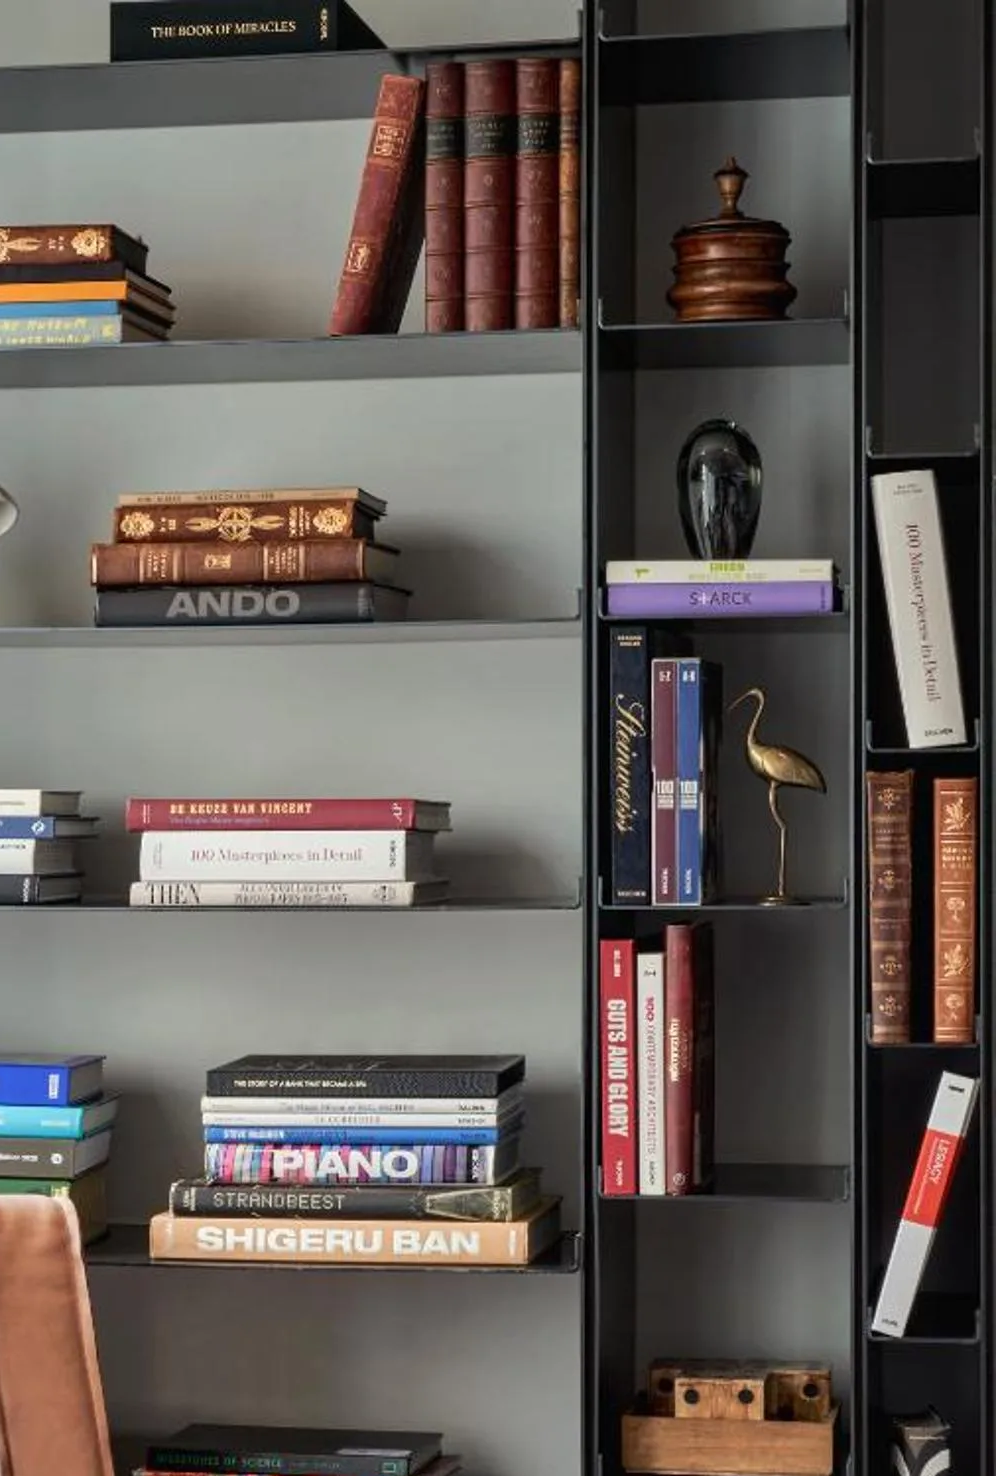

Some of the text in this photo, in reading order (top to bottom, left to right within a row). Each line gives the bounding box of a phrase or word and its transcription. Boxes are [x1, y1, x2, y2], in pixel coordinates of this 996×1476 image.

[151, 21, 297, 39] THE BOOK OF MIRACLES
[166, 590, 300, 618] ANDO
[689, 591, 752, 606] STARCK
[905, 523, 942, 703] 100 Masterpieces in Detail
[614, 694, 646, 834] Steinweiss
[190, 803, 228, 815] KEUZE
[233, 803, 255, 815] VAN
[260, 803, 313, 815] VINCENT
[190, 849, 215, 862] 100
[218, 848, 304, 865] Masterpieces
[323, 848, 362, 861] Detail
[147, 883, 201, 905] THEN
[607, 999, 628, 1044] GUTS
[645, 996, 655, 1023] 100
[607, 1046, 628, 1080] AND
[608, 1082, 629, 1138] GLORY
[273, 1150, 419, 1179] PIANO
[929, 1139, 952, 1184] LEGACY
[213, 1192, 347, 1211] STRANDBEEST
[197, 1227, 480, 1254] SHIGERU BAN
[241, 1457, 282, 1468] SCIENCE
